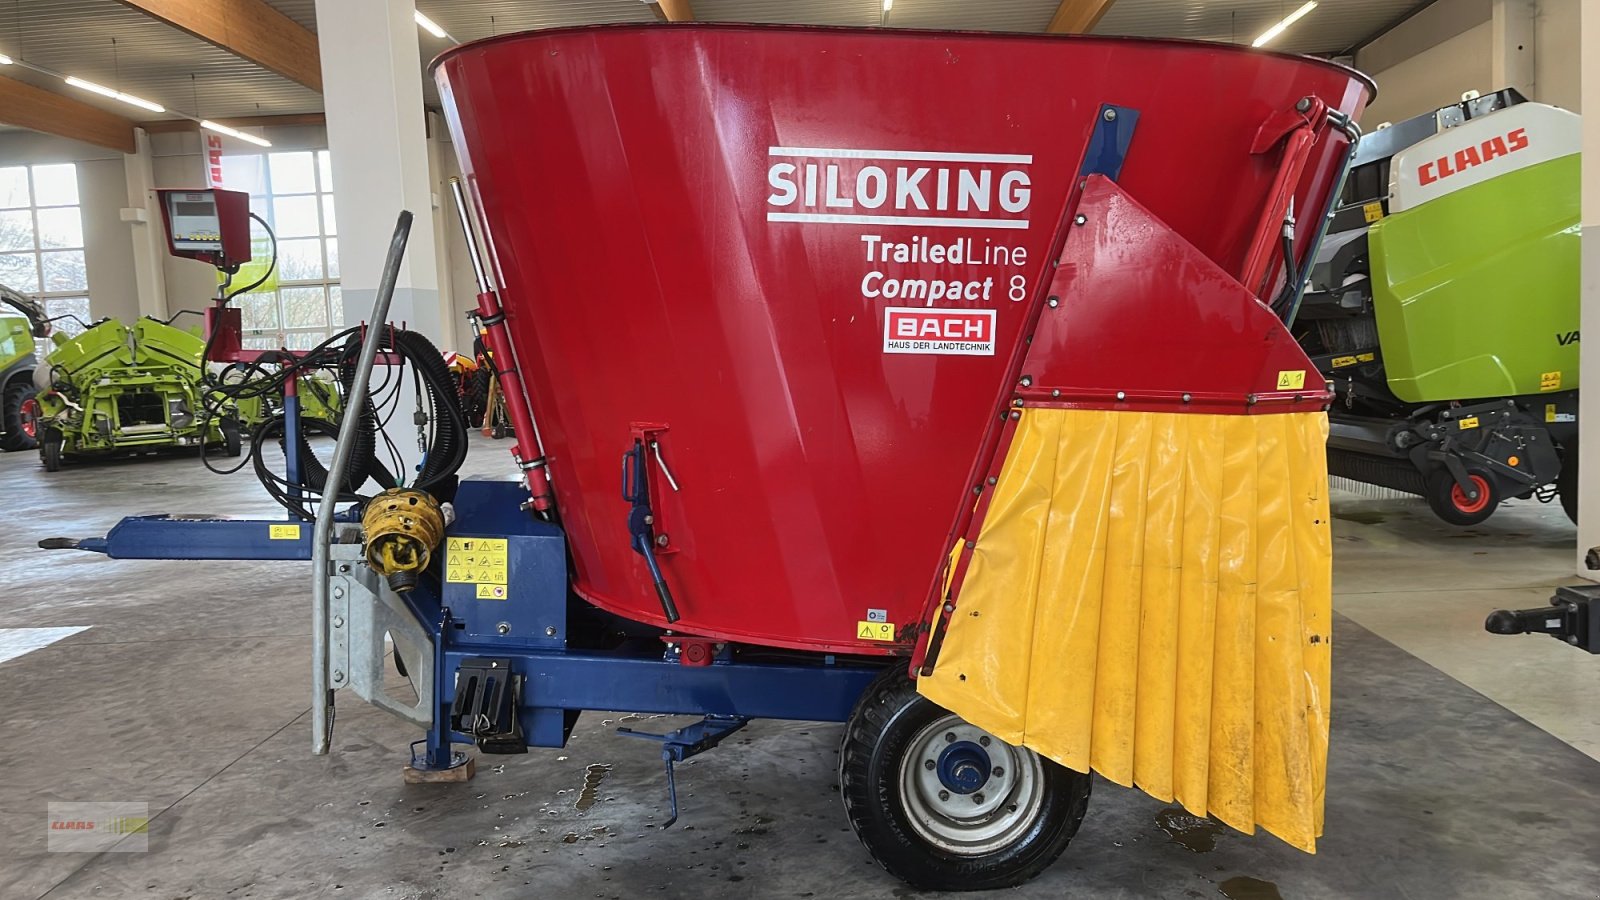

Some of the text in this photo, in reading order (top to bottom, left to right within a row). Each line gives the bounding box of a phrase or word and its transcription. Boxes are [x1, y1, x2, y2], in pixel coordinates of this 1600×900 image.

[207, 134, 223, 189] AAS
[1417, 127, 1529, 187] CLAAS
[767, 162, 1032, 213] SILOKING
[861, 234, 1027, 266] TrailedLine
[861, 271, 1026, 306] Compact 8
[897, 317, 983, 338] BACH
[888, 341, 991, 351] HAUS DER LANDTECHNIK
